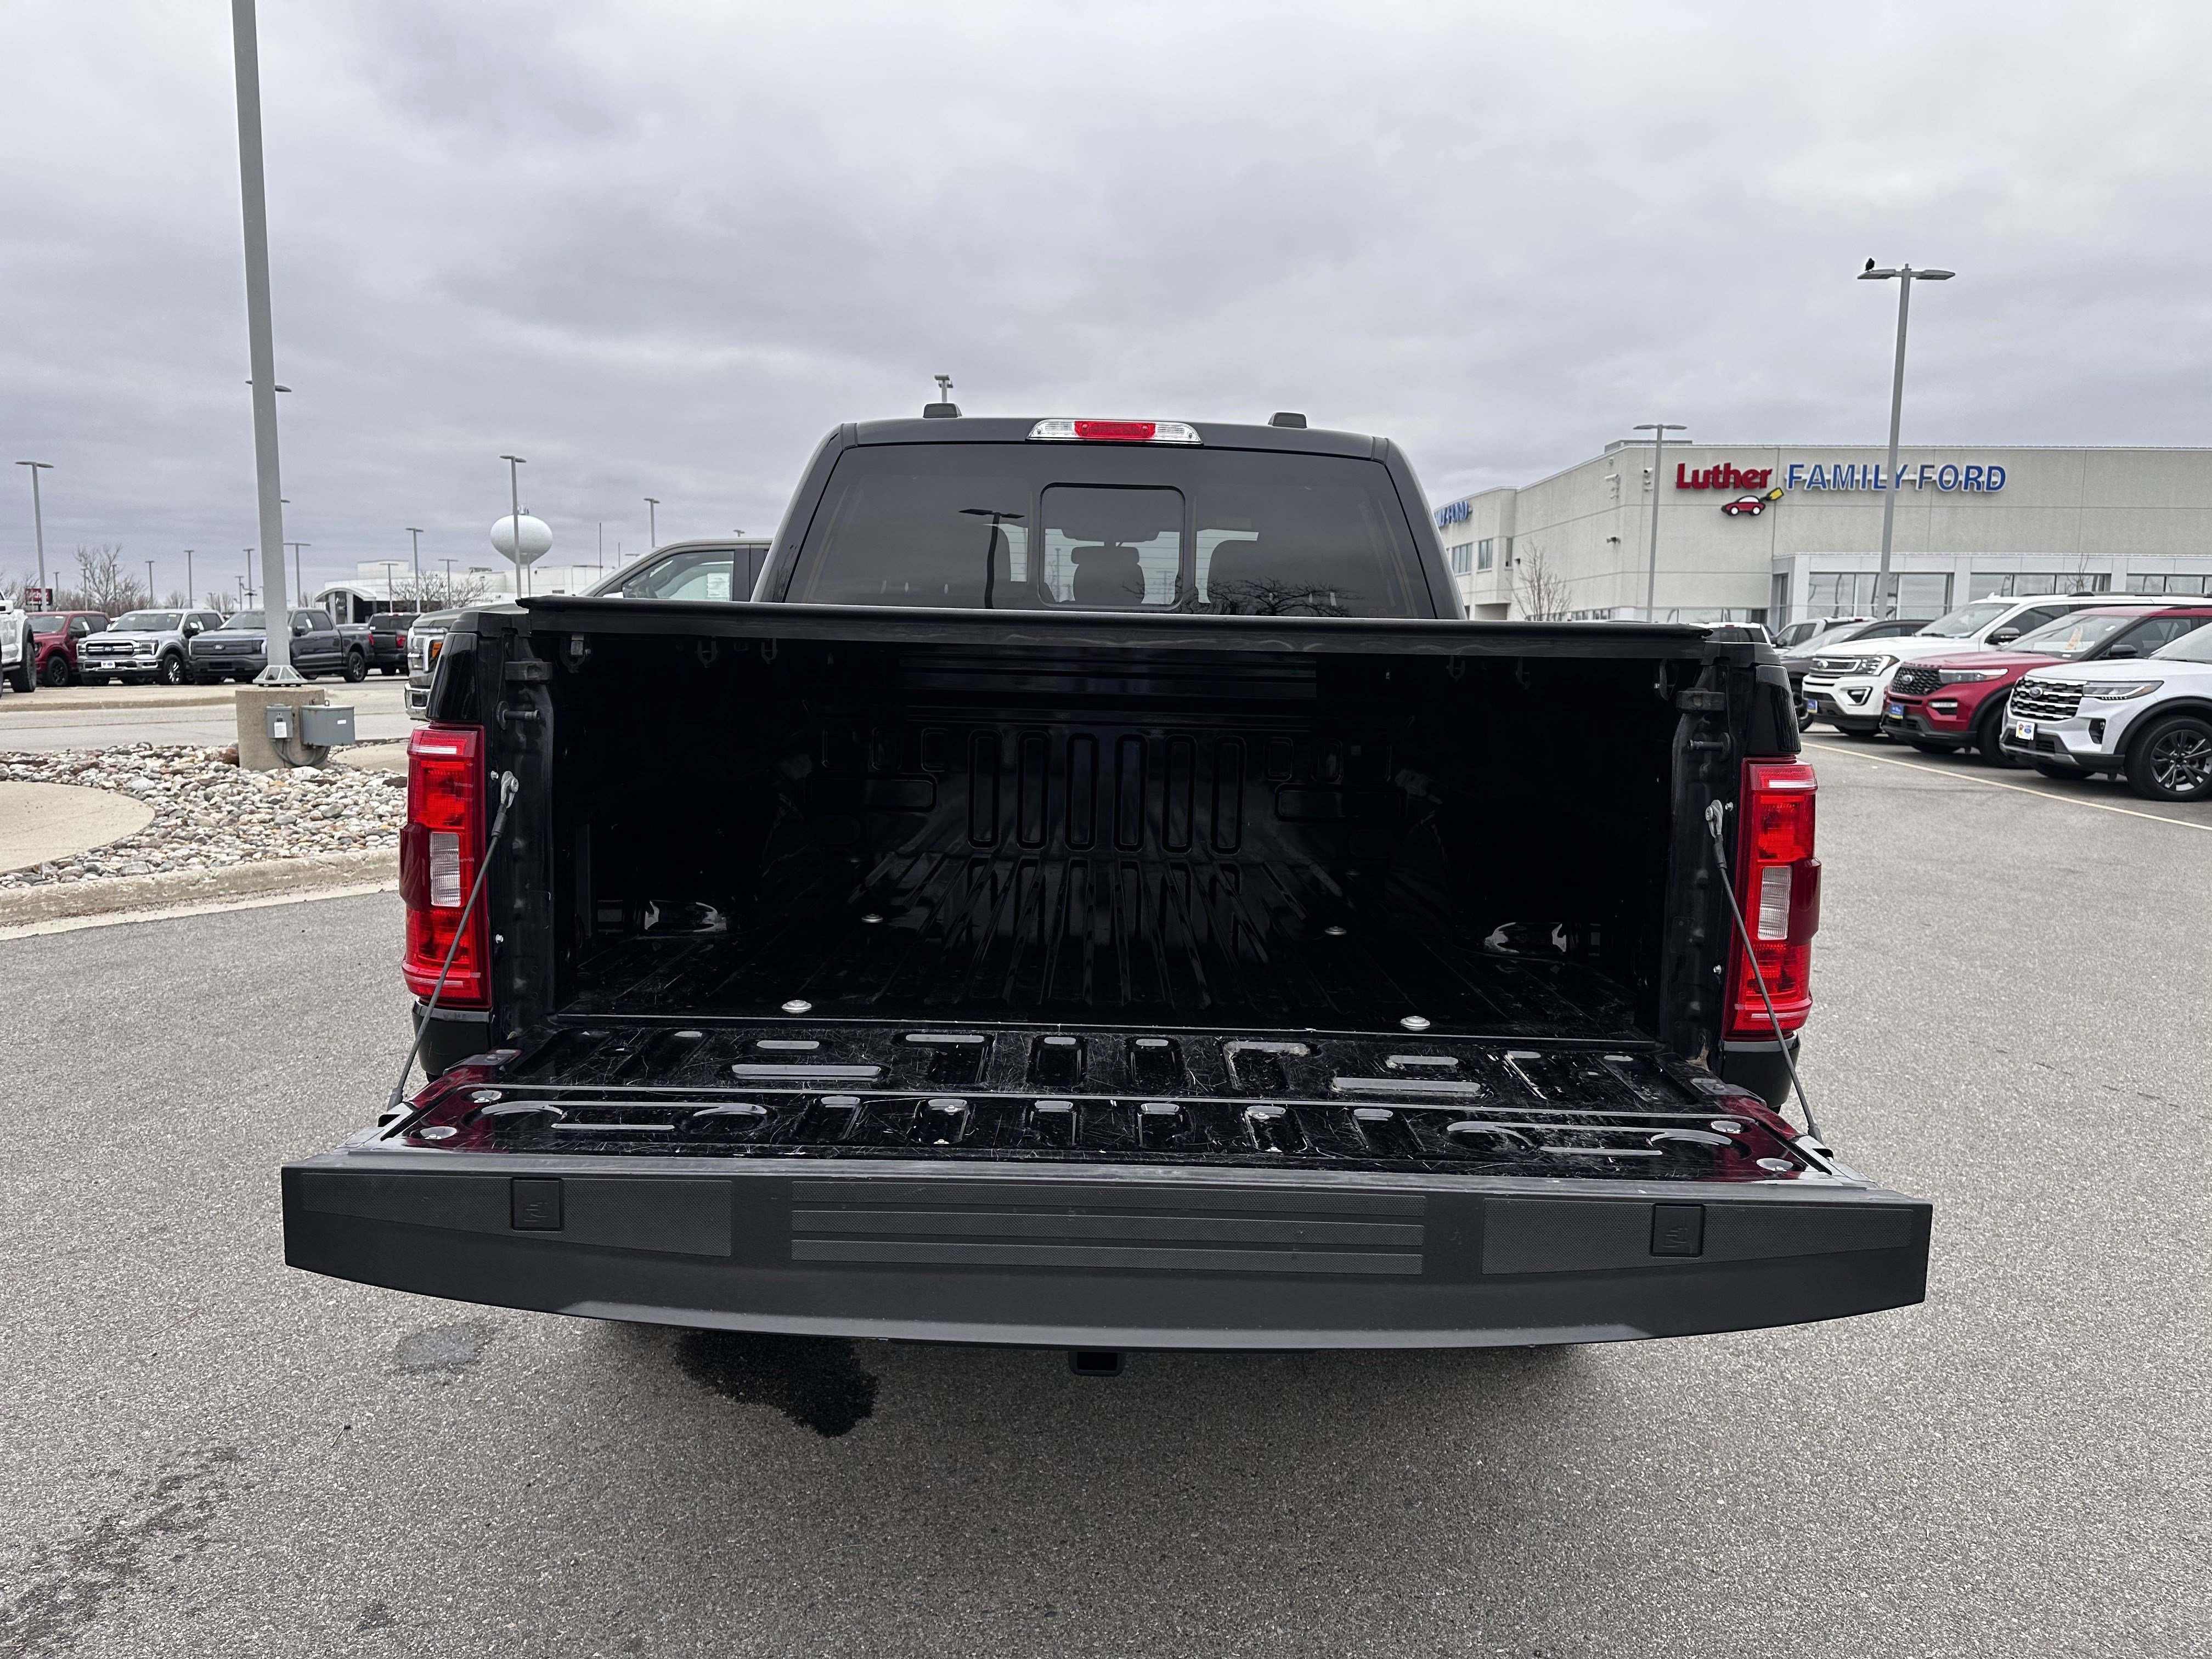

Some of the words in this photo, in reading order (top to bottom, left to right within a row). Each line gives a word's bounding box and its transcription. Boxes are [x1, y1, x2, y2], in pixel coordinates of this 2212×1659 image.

[1677, 462, 1773, 489] Luther
[1787, 464, 1909, 489] FAMILY
[1918, 464, 2006, 492] FORD
